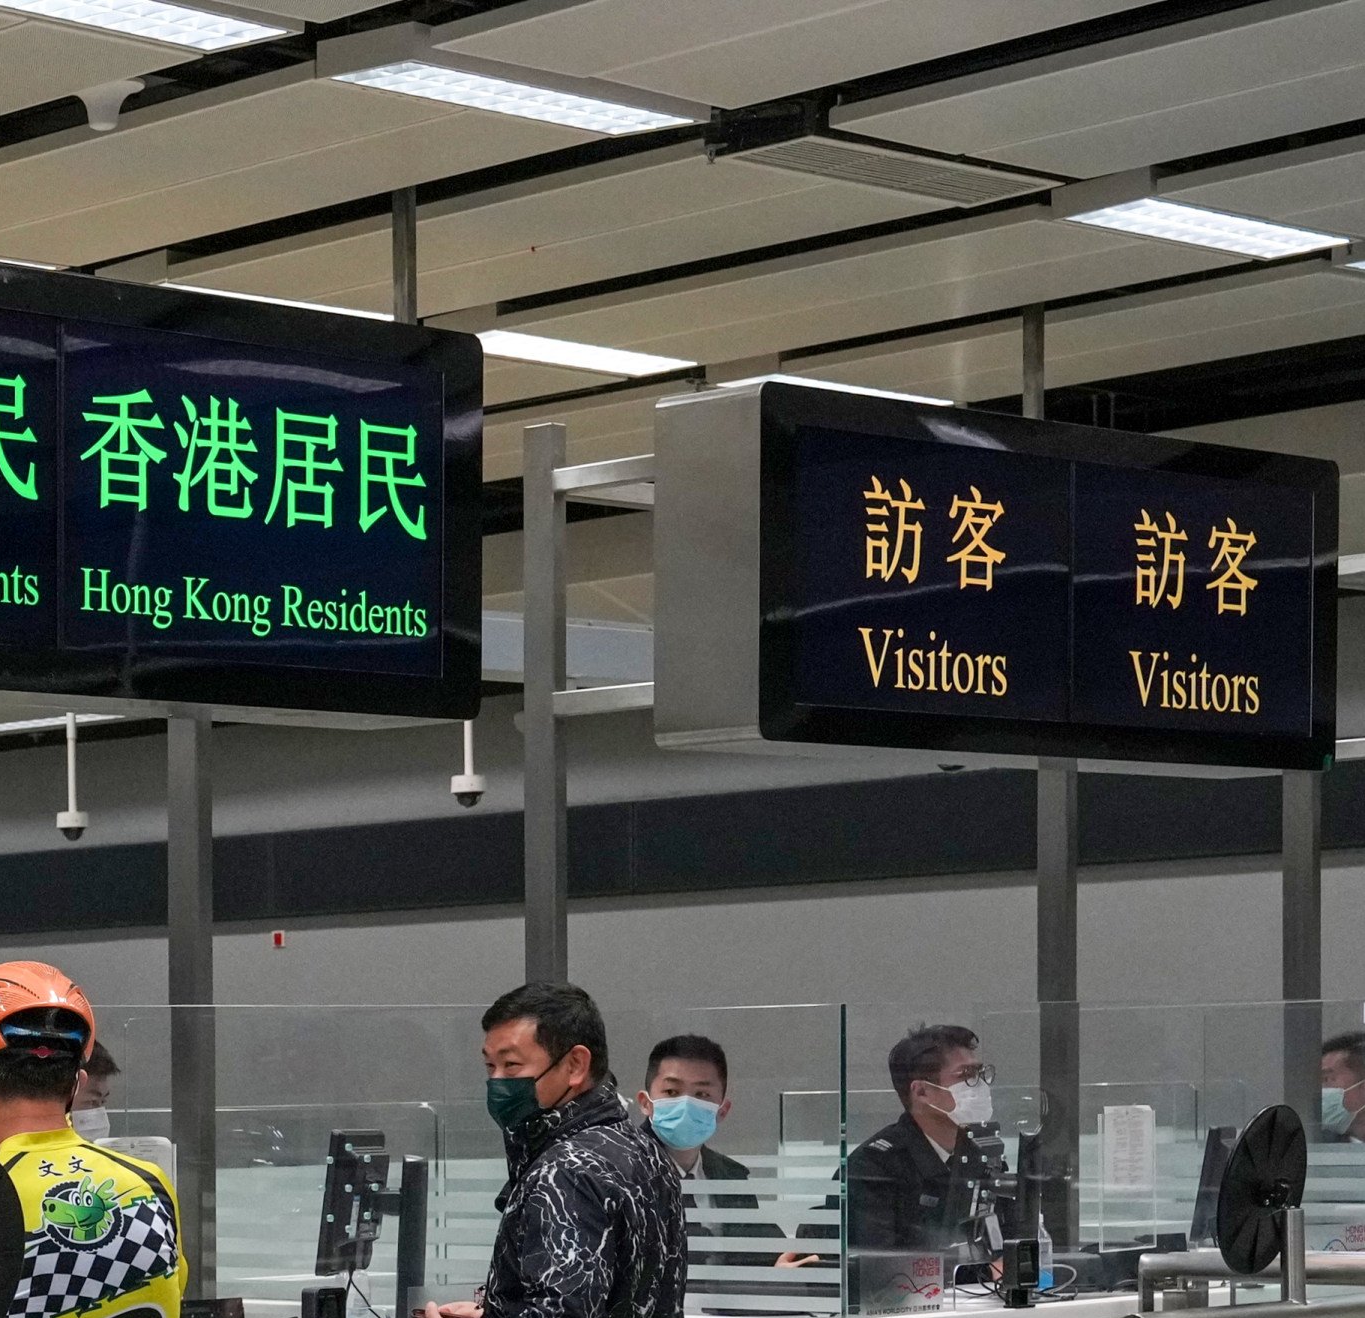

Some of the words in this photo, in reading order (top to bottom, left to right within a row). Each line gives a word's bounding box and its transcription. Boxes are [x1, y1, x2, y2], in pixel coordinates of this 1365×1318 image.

[80, 388, 428, 541] 香港居民
[863, 475, 1007, 591] 訪客
[1134, 509, 1259, 616] 訪客
[81, 567, 173, 630] Hong
[184, 576, 272, 637] Kong
[282, 585, 428, 638] Residents
[859, 627, 1008, 697] Visitors
[1129, 650, 1260, 714] Visitors
[38, 1155, 93, 1177] 文文
